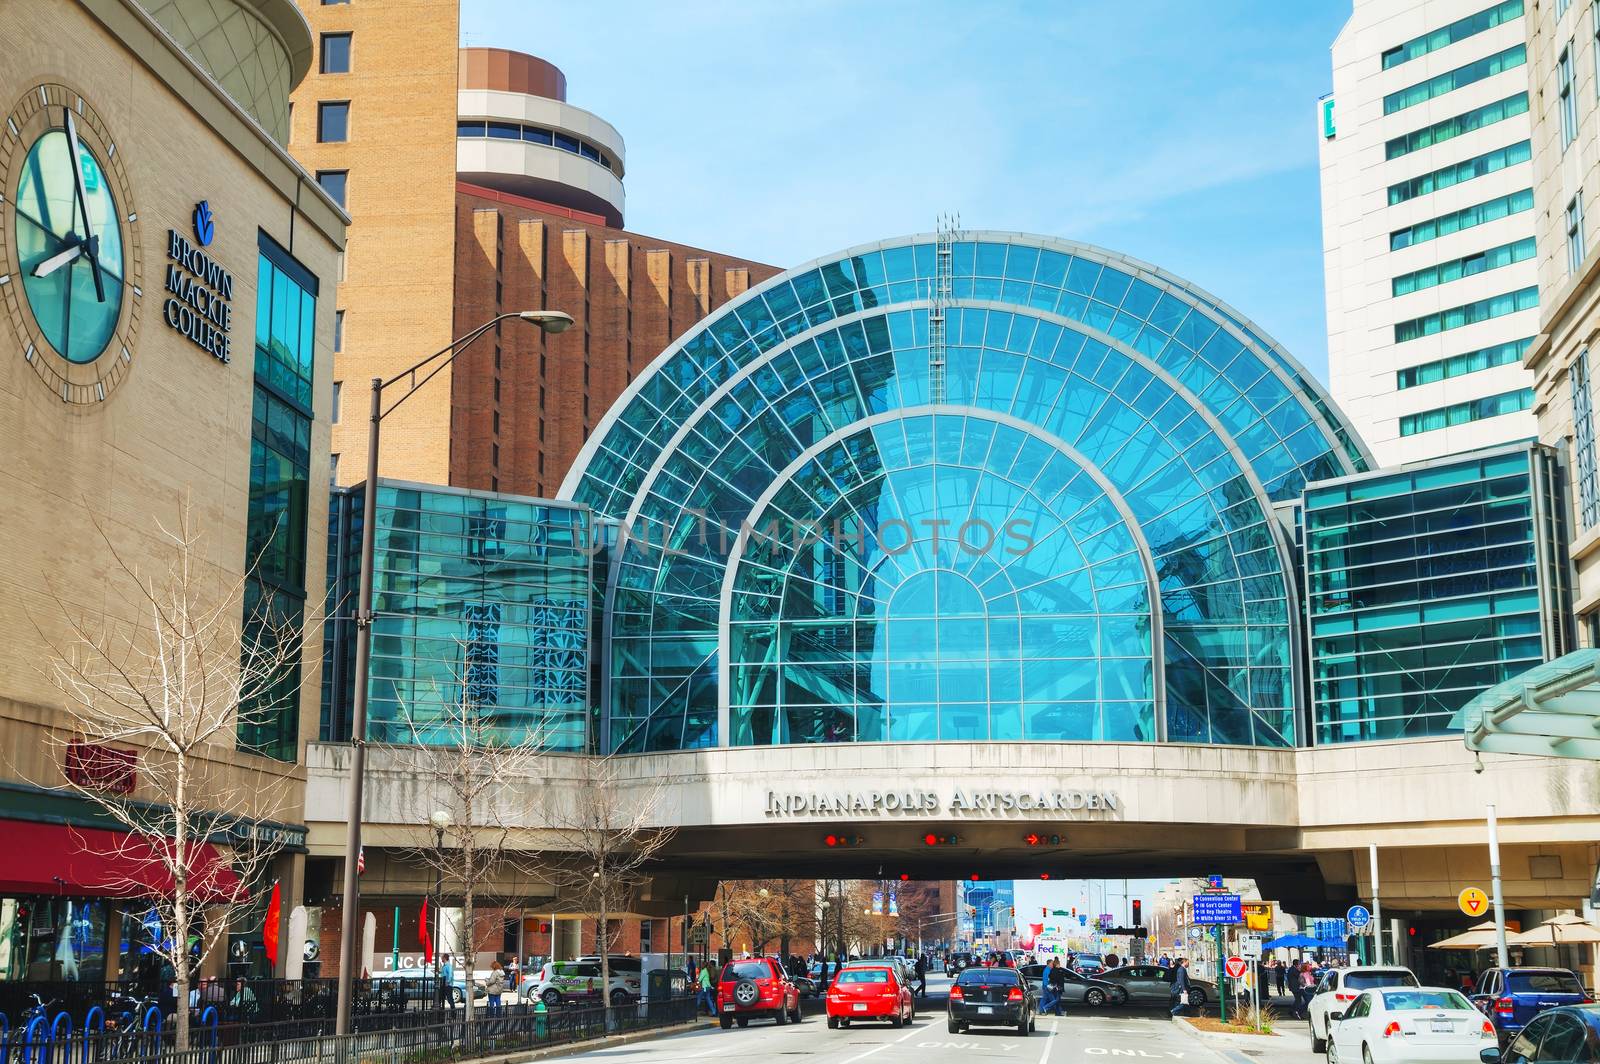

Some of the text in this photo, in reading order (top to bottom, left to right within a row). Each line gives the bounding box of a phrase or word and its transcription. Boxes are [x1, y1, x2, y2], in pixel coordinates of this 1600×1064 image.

[168, 229, 233, 301] BROWN
[166, 264, 231, 332] MACKIE
[164, 299, 231, 364] COLLEGE
[765, 788, 1119, 813] INDIANAPOLIS ARTSGARDEN
[1038, 944, 1065, 954] FedEx
[916, 1042, 1020, 1051] ONLY
[1084, 1047, 1185, 1059] ONLY
